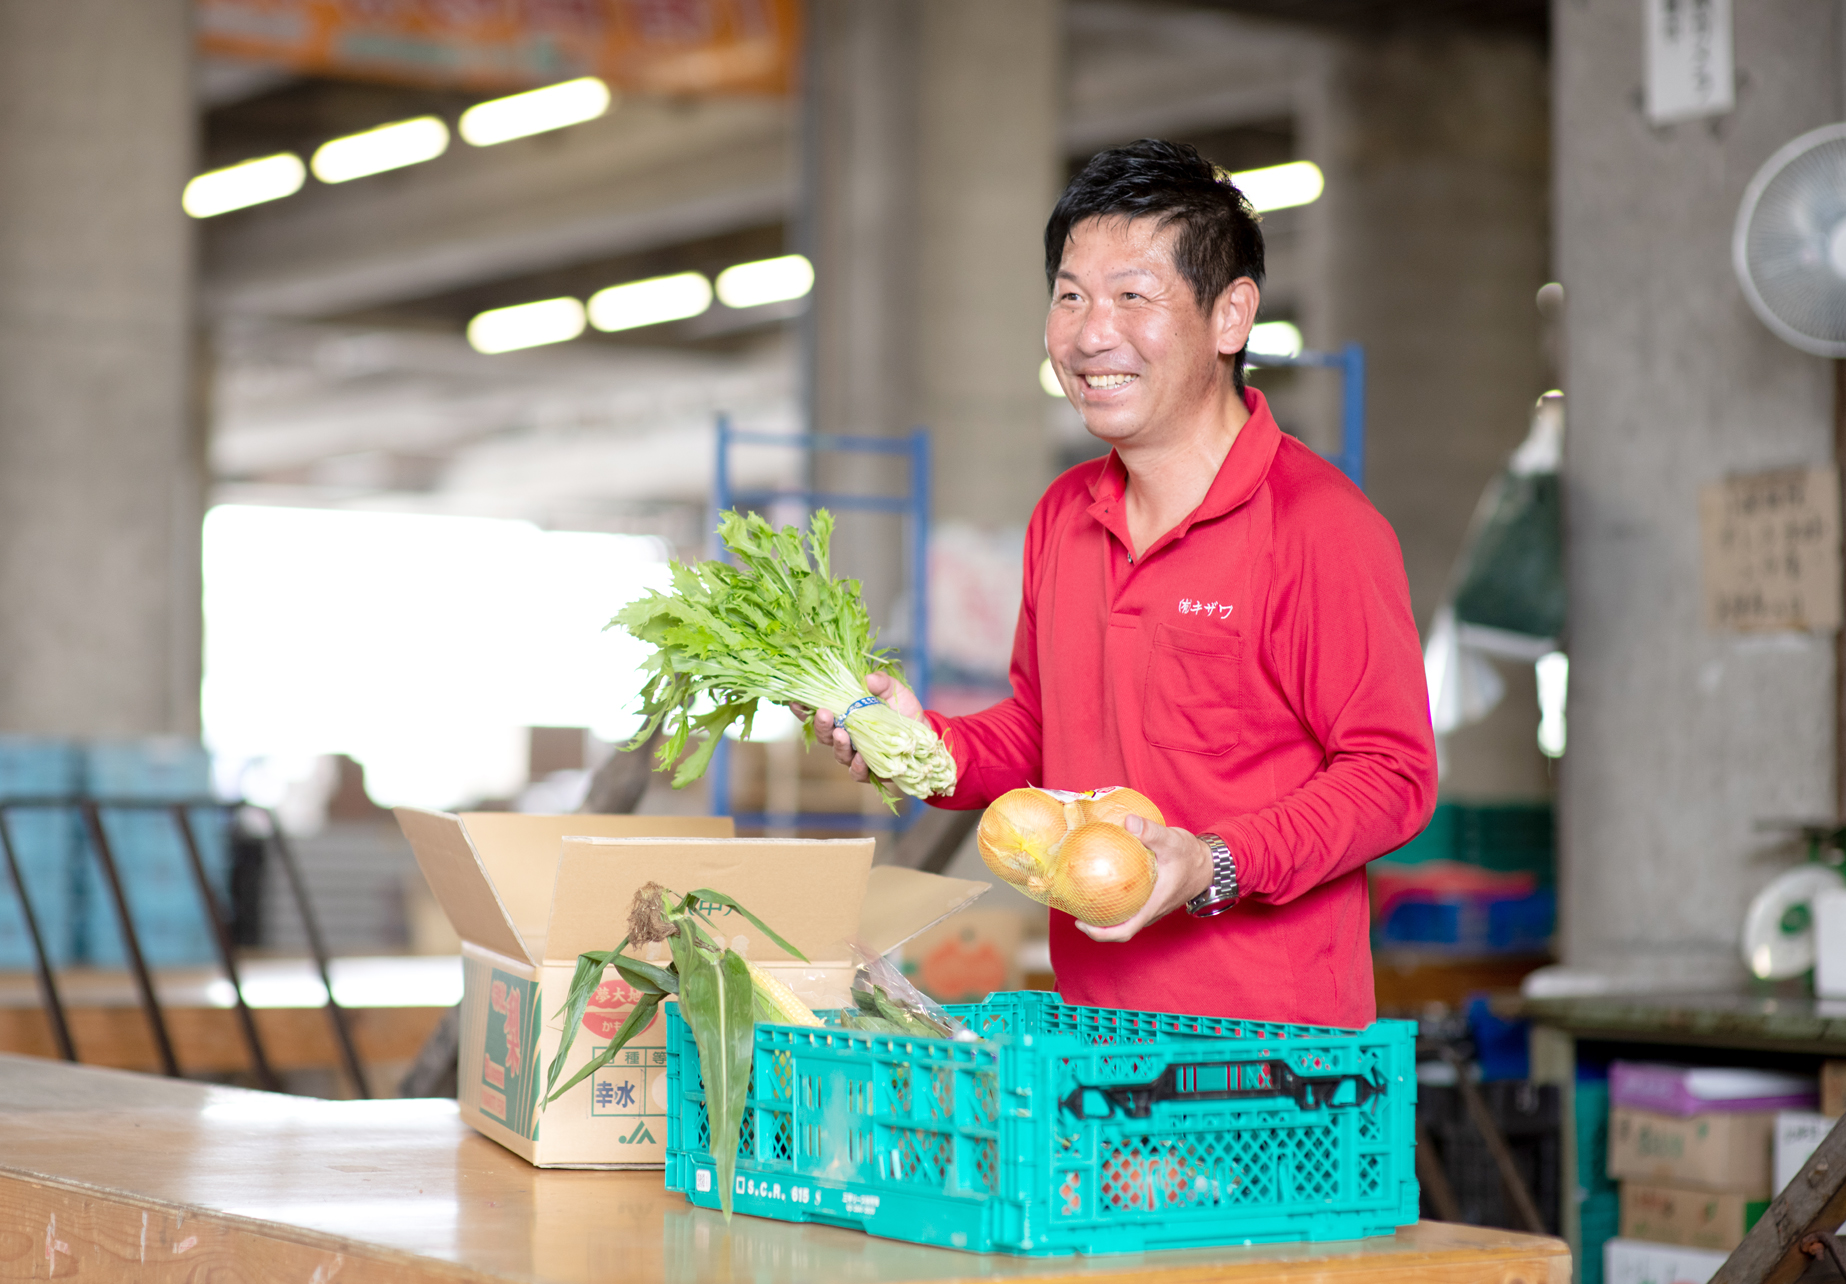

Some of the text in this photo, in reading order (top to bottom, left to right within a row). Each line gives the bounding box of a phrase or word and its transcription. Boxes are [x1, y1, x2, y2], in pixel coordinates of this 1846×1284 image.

[595, 986, 642, 1004] 夢大地
[595, 1080, 636, 1108] 幸水
